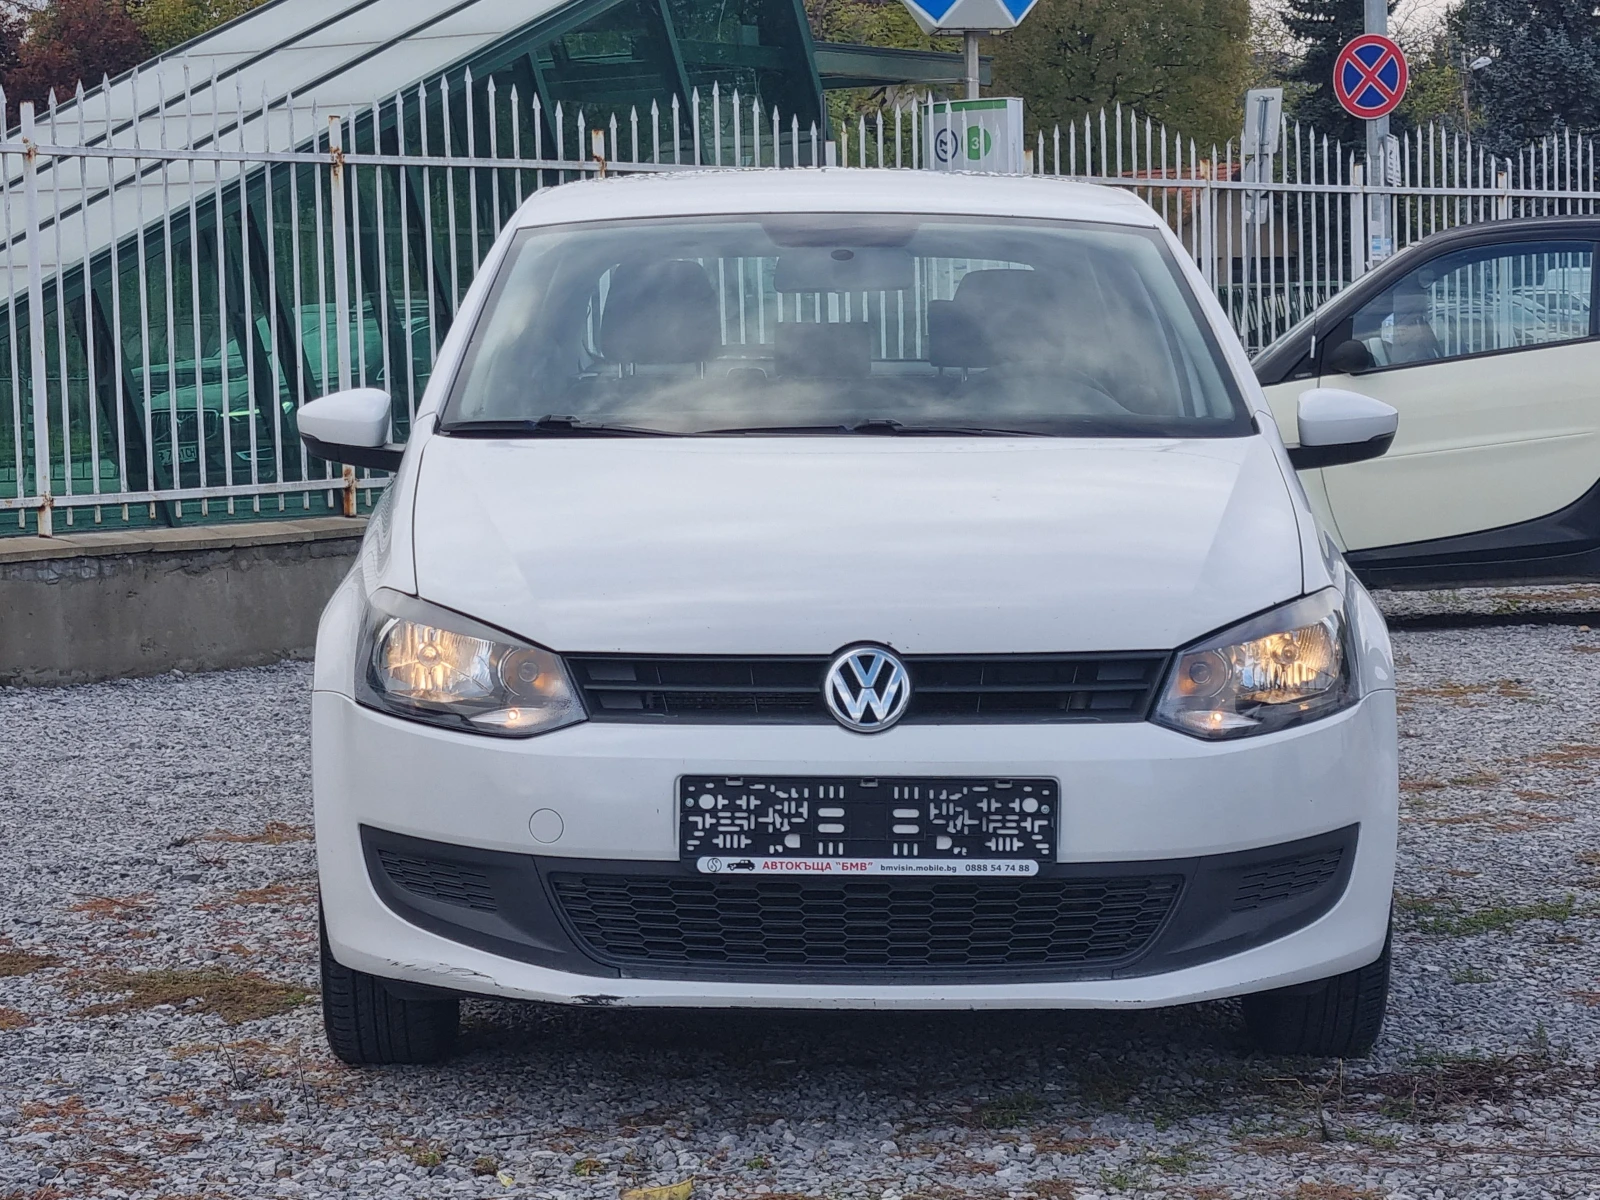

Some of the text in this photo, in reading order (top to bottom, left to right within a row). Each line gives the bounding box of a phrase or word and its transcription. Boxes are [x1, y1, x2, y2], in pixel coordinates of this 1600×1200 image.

[971, 137, 980, 150] 3
[829, 652, 905, 724] VW
[762, 861, 832, 872] АВТОКЪЩА
[880, 864, 957, 873] bmvisin.mobile.bg
[964, 864, 1030, 872] 0888 54 74 88
